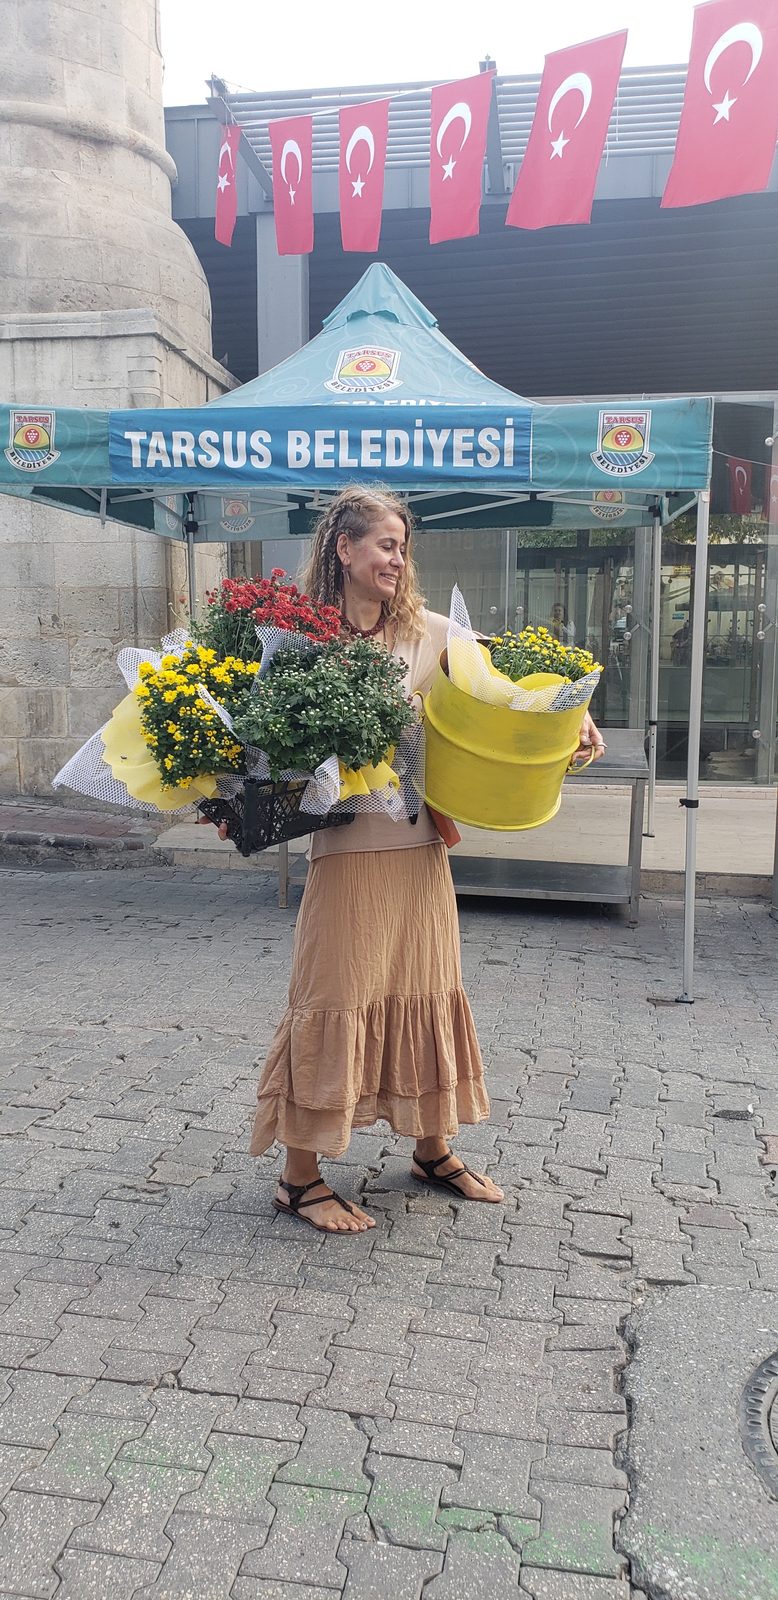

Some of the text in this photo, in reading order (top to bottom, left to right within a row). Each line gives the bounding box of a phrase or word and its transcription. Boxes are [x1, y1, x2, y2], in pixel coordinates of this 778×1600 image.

[15, 415, 50, 424] TARSUS
[605, 415, 645, 424] TARSUS
[125, 417, 515, 469] TARSUS BELEDİYESİ
